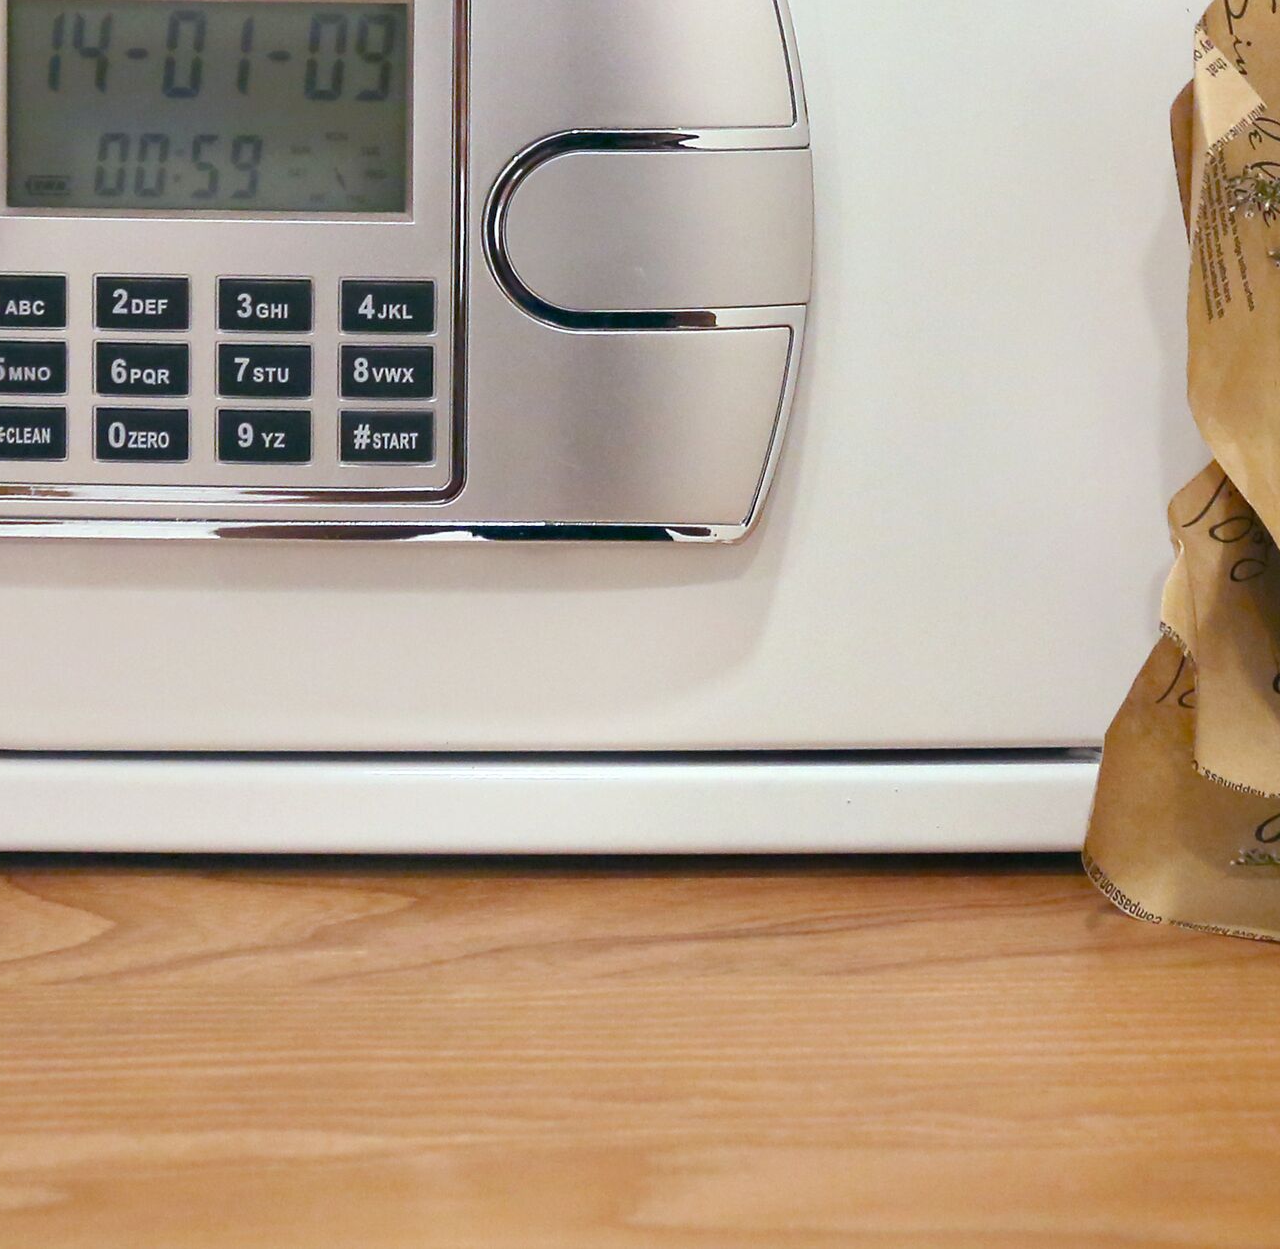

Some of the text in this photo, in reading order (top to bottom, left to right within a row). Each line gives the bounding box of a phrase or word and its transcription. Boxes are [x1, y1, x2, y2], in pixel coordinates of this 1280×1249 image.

[48, 10, 397, 101] 14-01-09
[1204, 55, 1229, 79] that
[94, 132, 263, 199] 00:59
